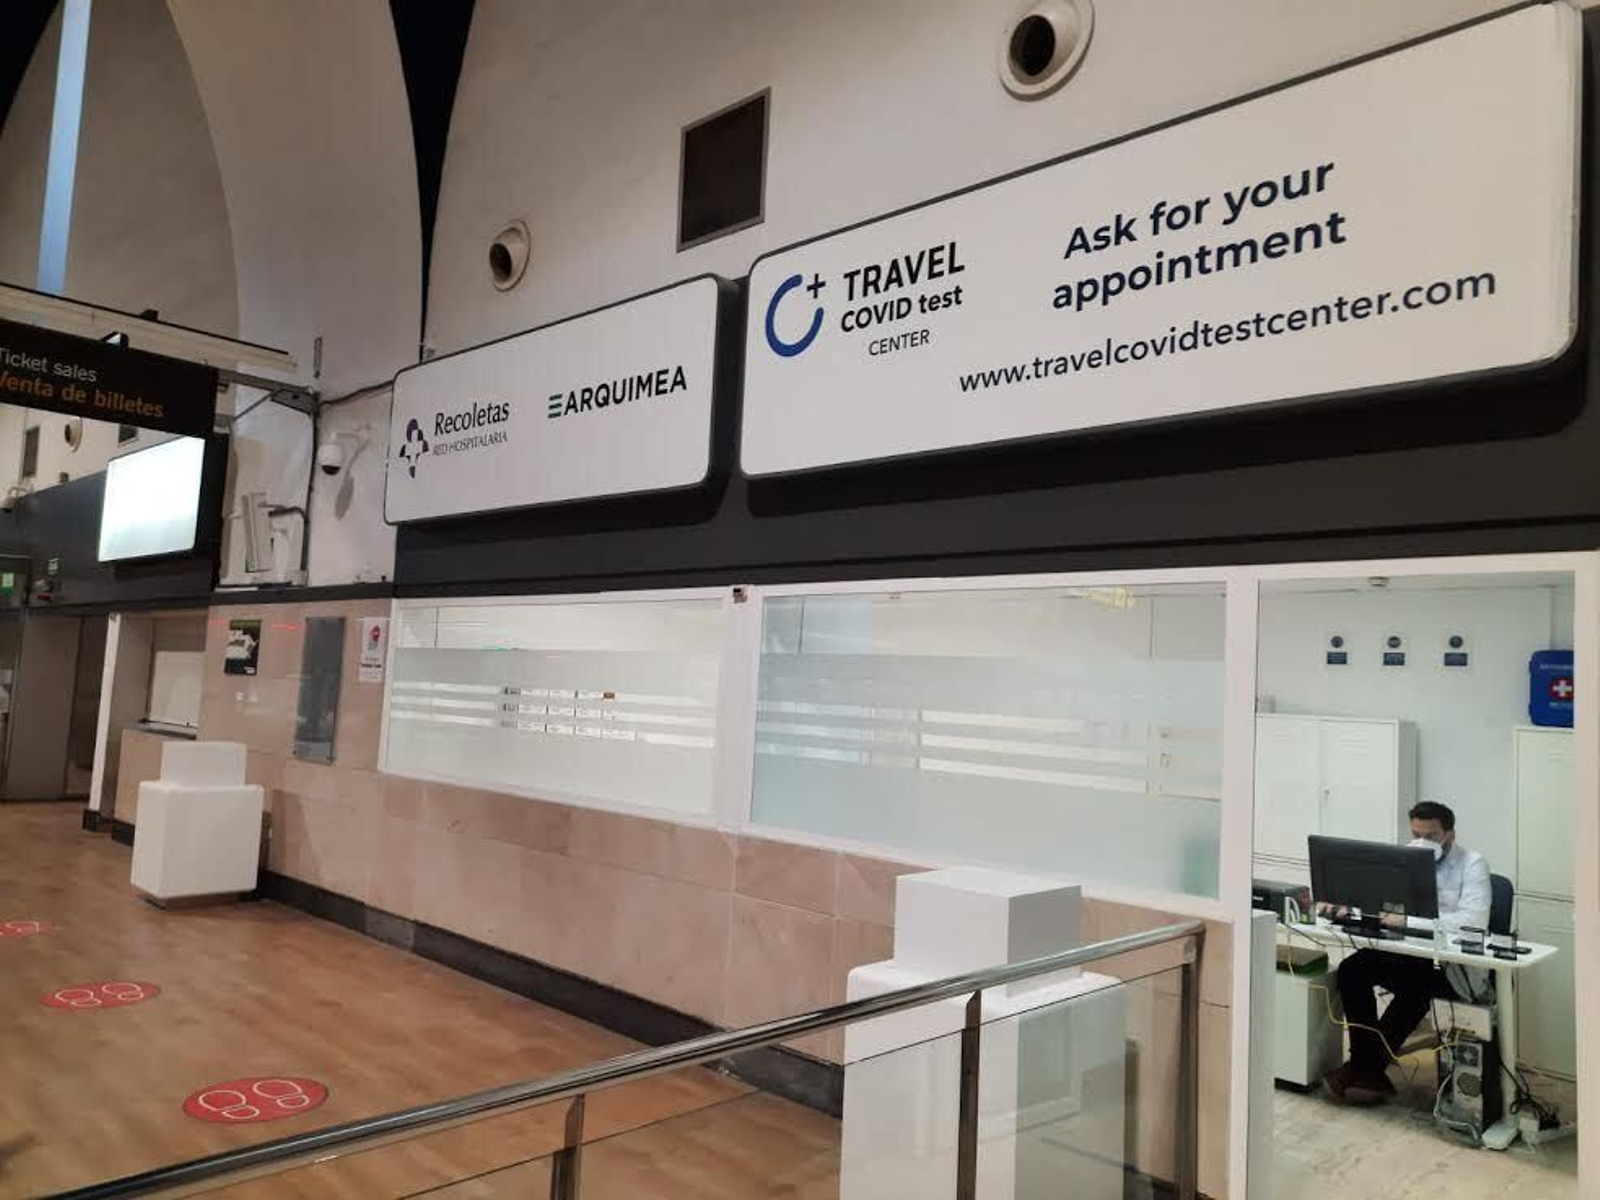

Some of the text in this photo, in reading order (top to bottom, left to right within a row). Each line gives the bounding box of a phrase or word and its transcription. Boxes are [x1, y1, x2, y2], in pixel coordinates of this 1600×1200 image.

[1064, 162, 1335, 260] Ask for your
[843, 241, 965, 301] TRAVEL
[1053, 212, 1347, 312] appointment
[841, 285, 964, 333] COVID test
[868, 329, 931, 356] CENTER
[959, 271, 1497, 393] www.travelcovidtestcenter.com
[53, 362, 97, 383] sales
[61, 383, 88, 404] de
[94, 389, 165, 418] billetes
[434, 402, 510, 437] Recoletas
[432, 431, 509, 456] RED HOSPITALARIA
